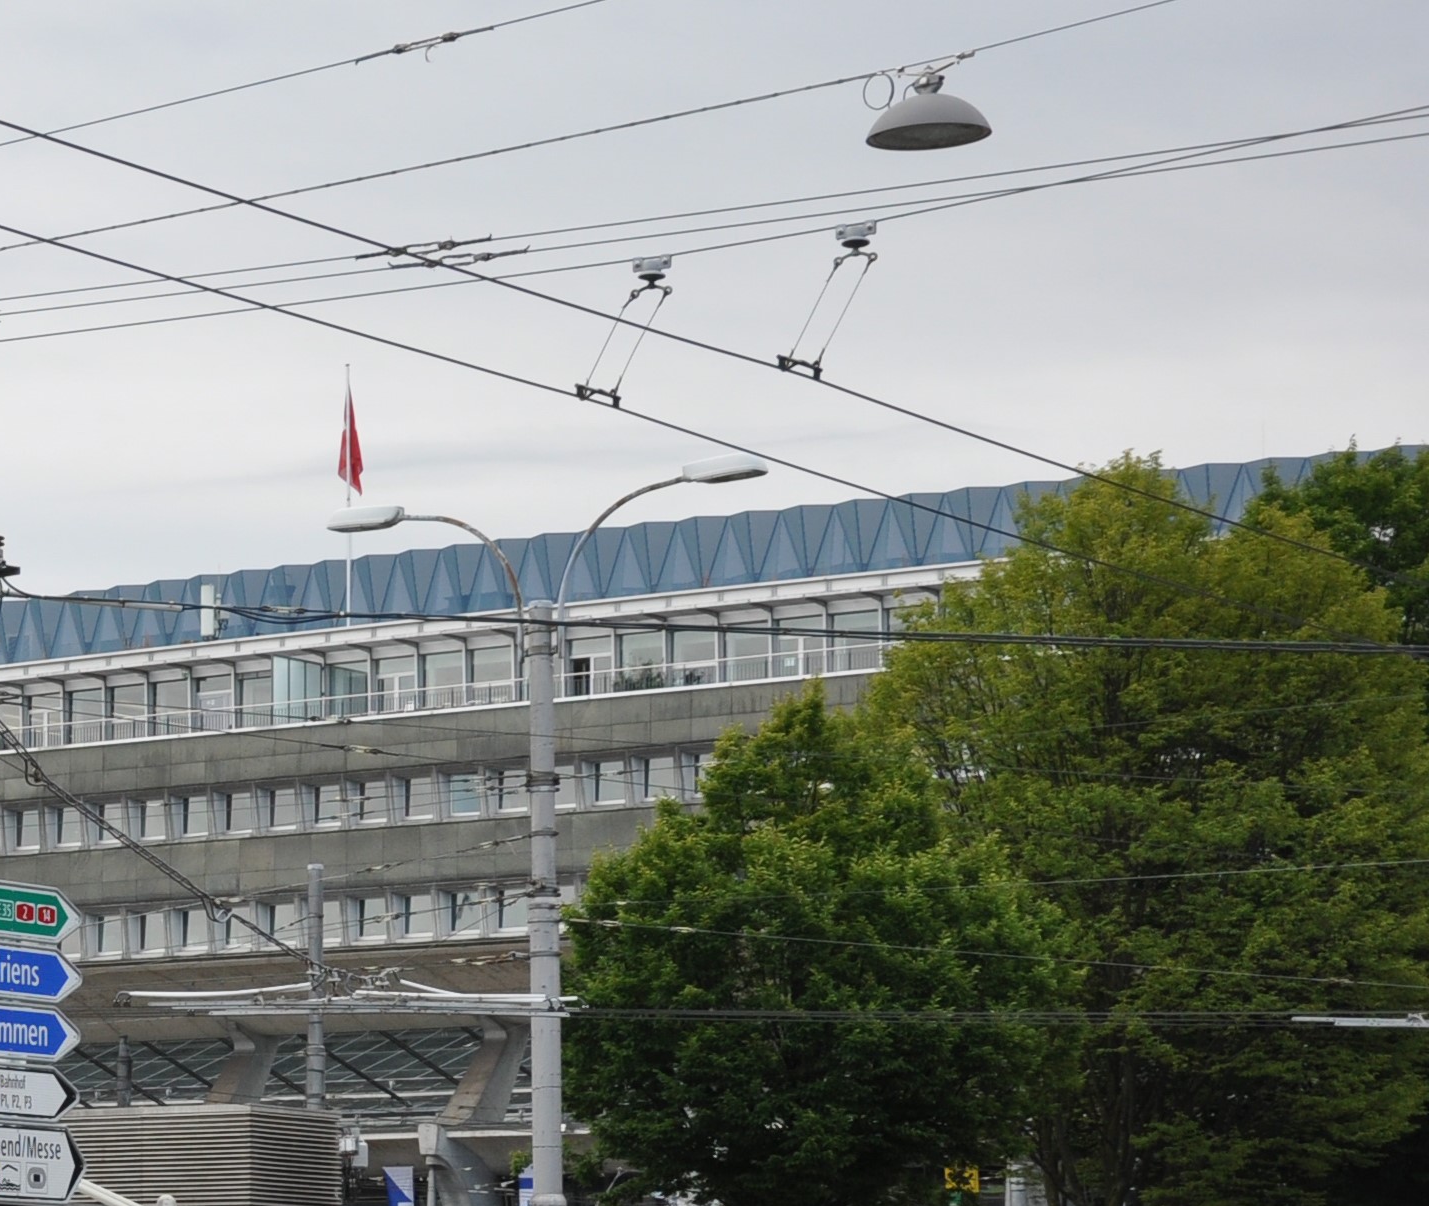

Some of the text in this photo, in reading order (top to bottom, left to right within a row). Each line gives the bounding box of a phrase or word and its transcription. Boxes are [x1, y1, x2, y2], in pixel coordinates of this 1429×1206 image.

[22, 906, 28, 920] 2
[42, 909, 51, 922] 14
[0, 1074, 27, 1089] Bahnhof
[24, 1095, 33, 1109] P3
